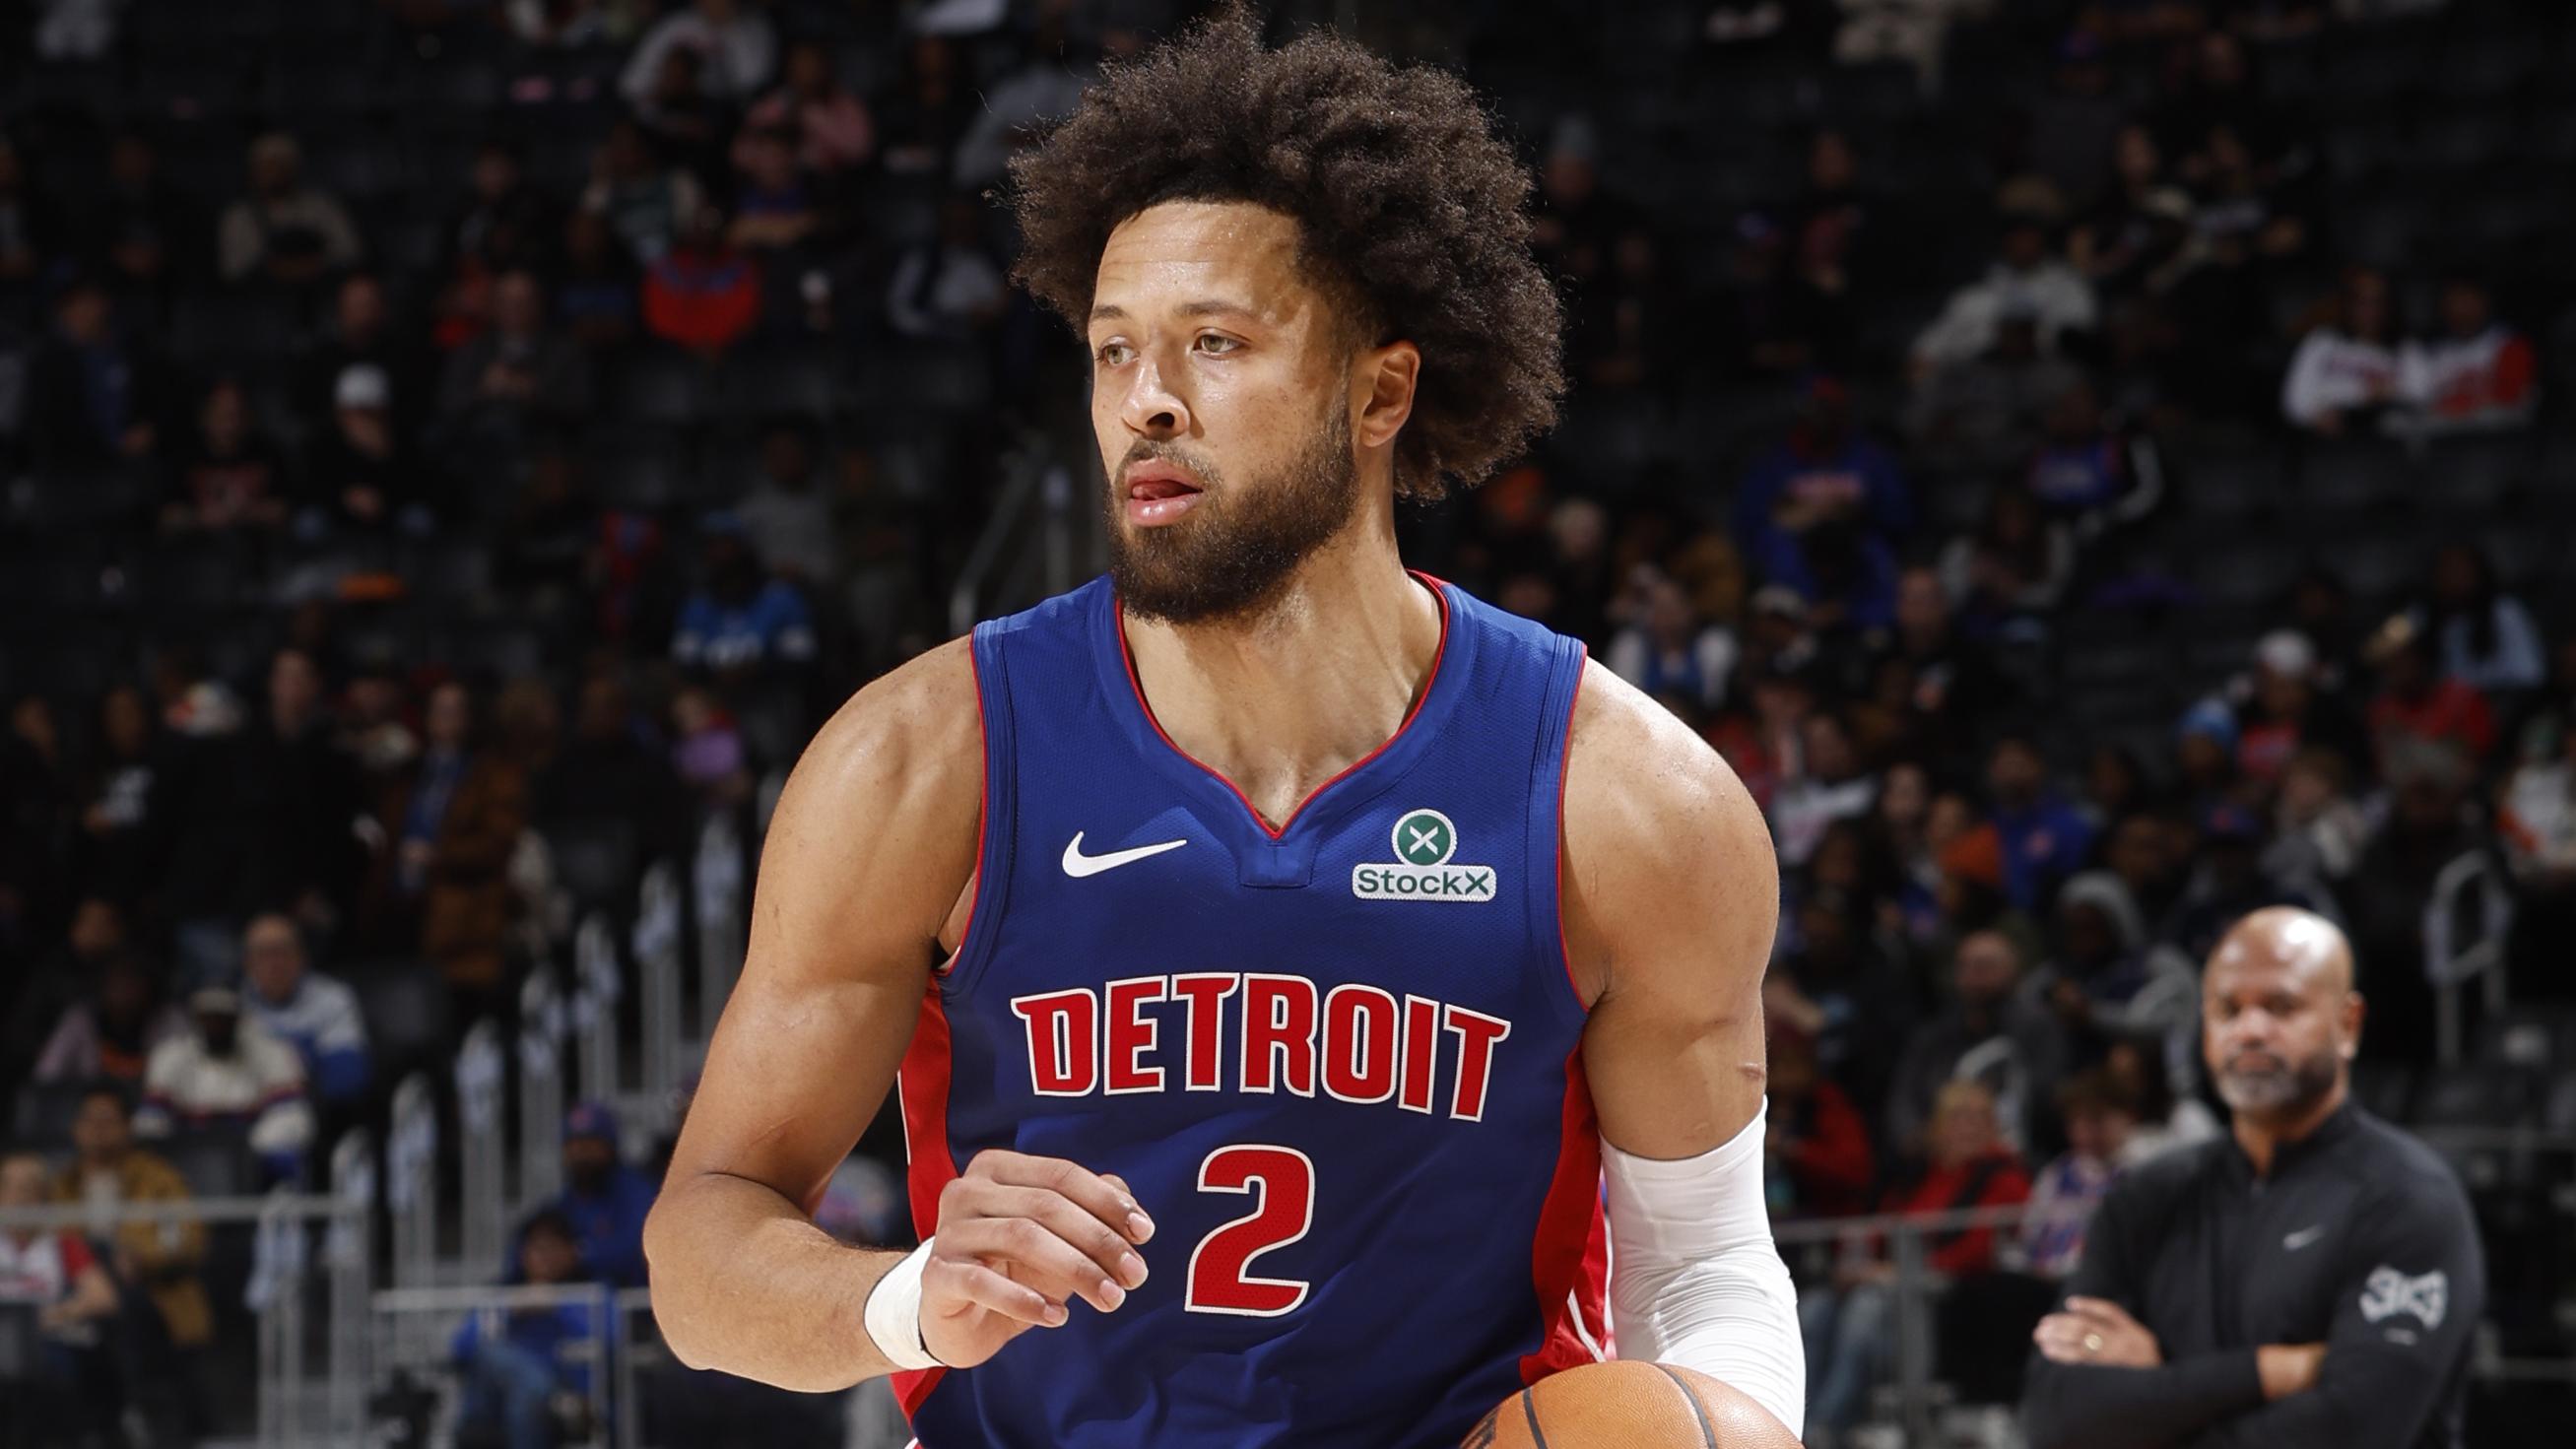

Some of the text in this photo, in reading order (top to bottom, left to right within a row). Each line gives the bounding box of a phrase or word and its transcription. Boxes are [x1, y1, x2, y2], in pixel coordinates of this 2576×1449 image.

[1357, 869, 1489, 895] StockX
[1010, 971, 1512, 1123] DETROIT
[1184, 1144, 1316, 1318] 2
